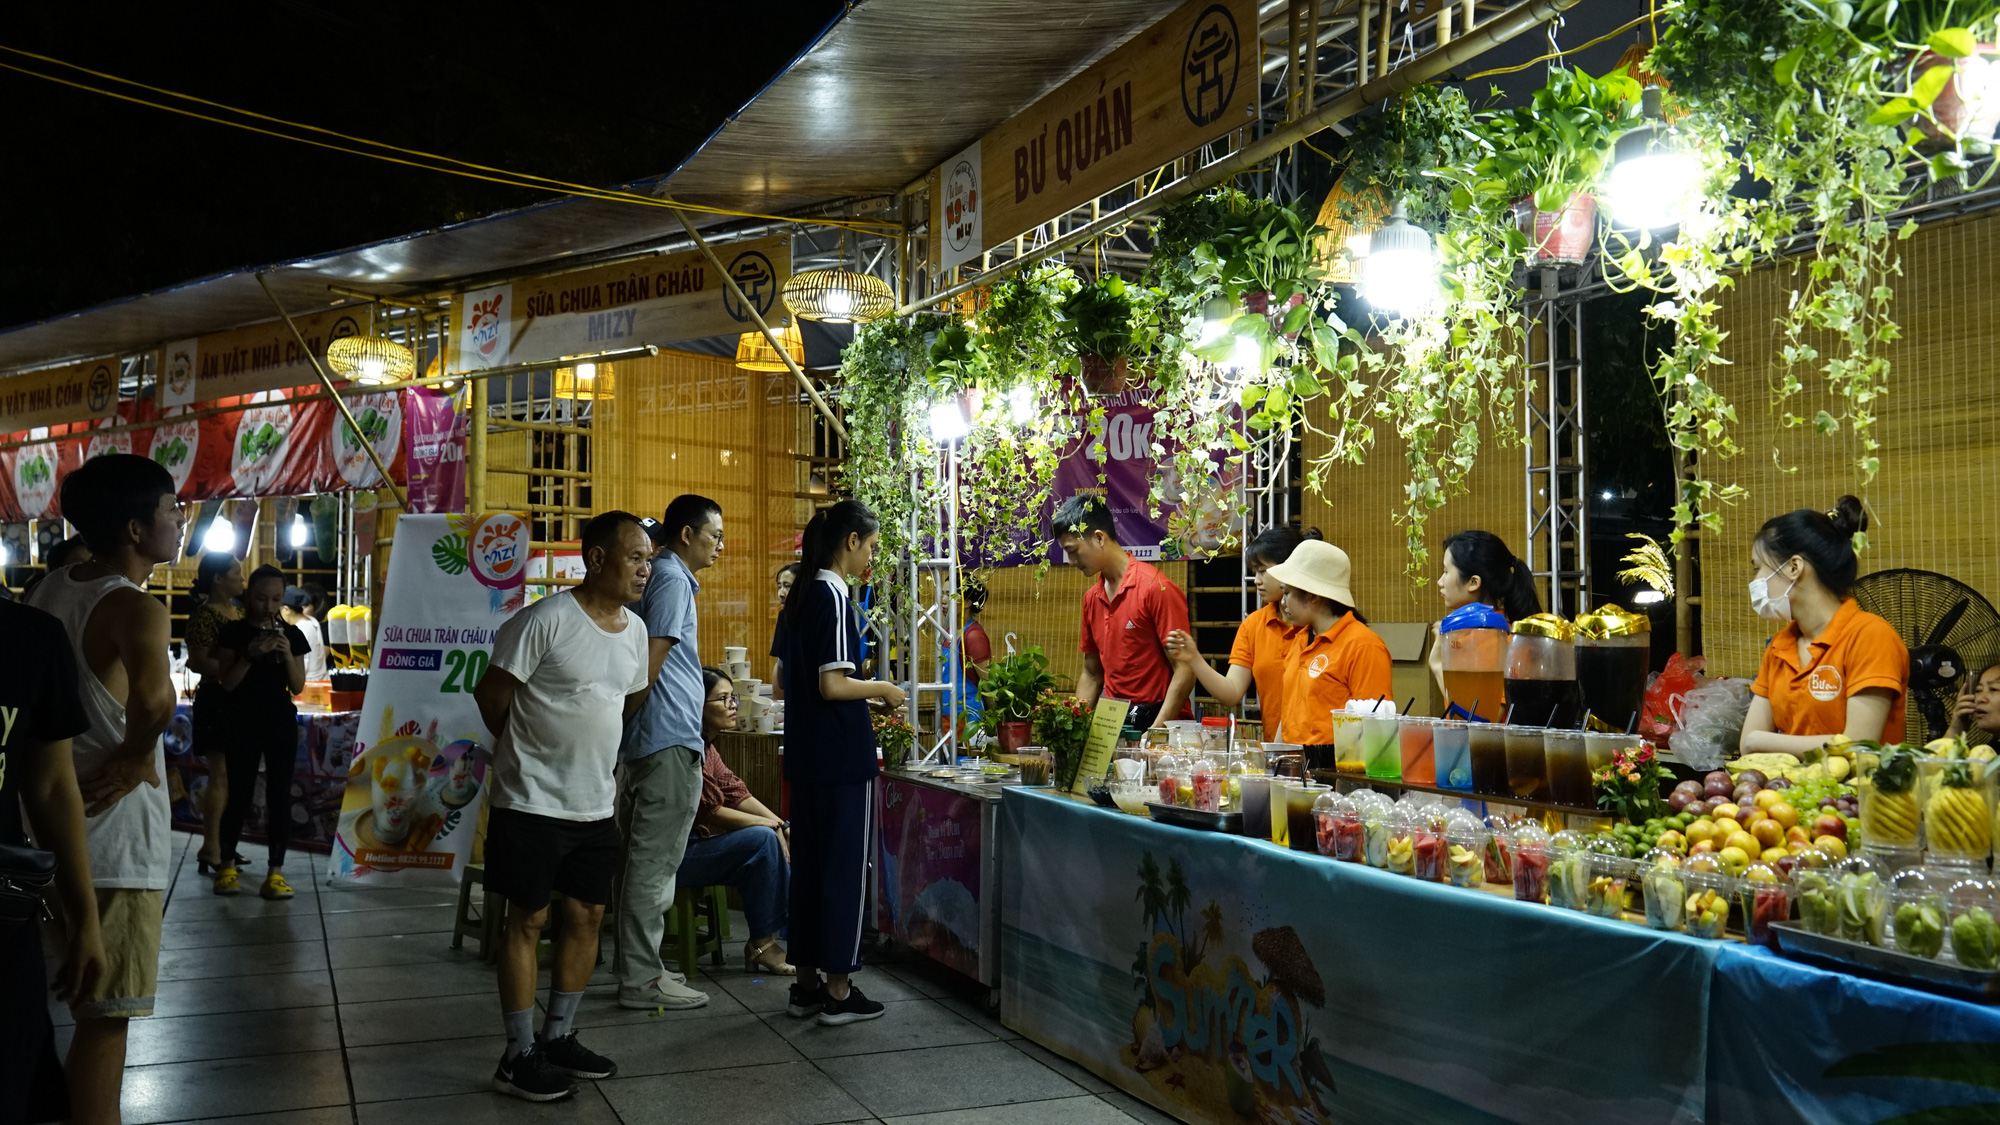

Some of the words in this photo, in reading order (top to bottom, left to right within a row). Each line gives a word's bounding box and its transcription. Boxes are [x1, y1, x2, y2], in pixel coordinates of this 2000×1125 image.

[1014, 122, 1048, 205] BƯ
[1055, 77, 1133, 186] QUÁN
[526, 289, 555, 320] SỮA
[559, 284, 602, 314] CHUA
[606, 272, 650, 306] TRÂN
[655, 263, 705, 298] CHÂU
[587, 308, 638, 343] MIZY
[201, 353, 219, 381] ĂN
[223, 345, 248, 382] VẶT
[252, 337, 281, 373] NHÀ
[29, 382, 52, 413] NHÀ
[55, 375, 83, 409] CỐM
[439, 441, 463, 463] 20K
[484, 543, 517, 566] MIZY
[383, 624, 403, 643] SỮA
[406, 627, 431, 643] CHUA
[434, 625, 459, 644] TRÂN
[461, 625, 488, 644] CHÂU
[385, 651, 416, 668] ĐỒNG
[417, 653, 435, 668] GIÁ
